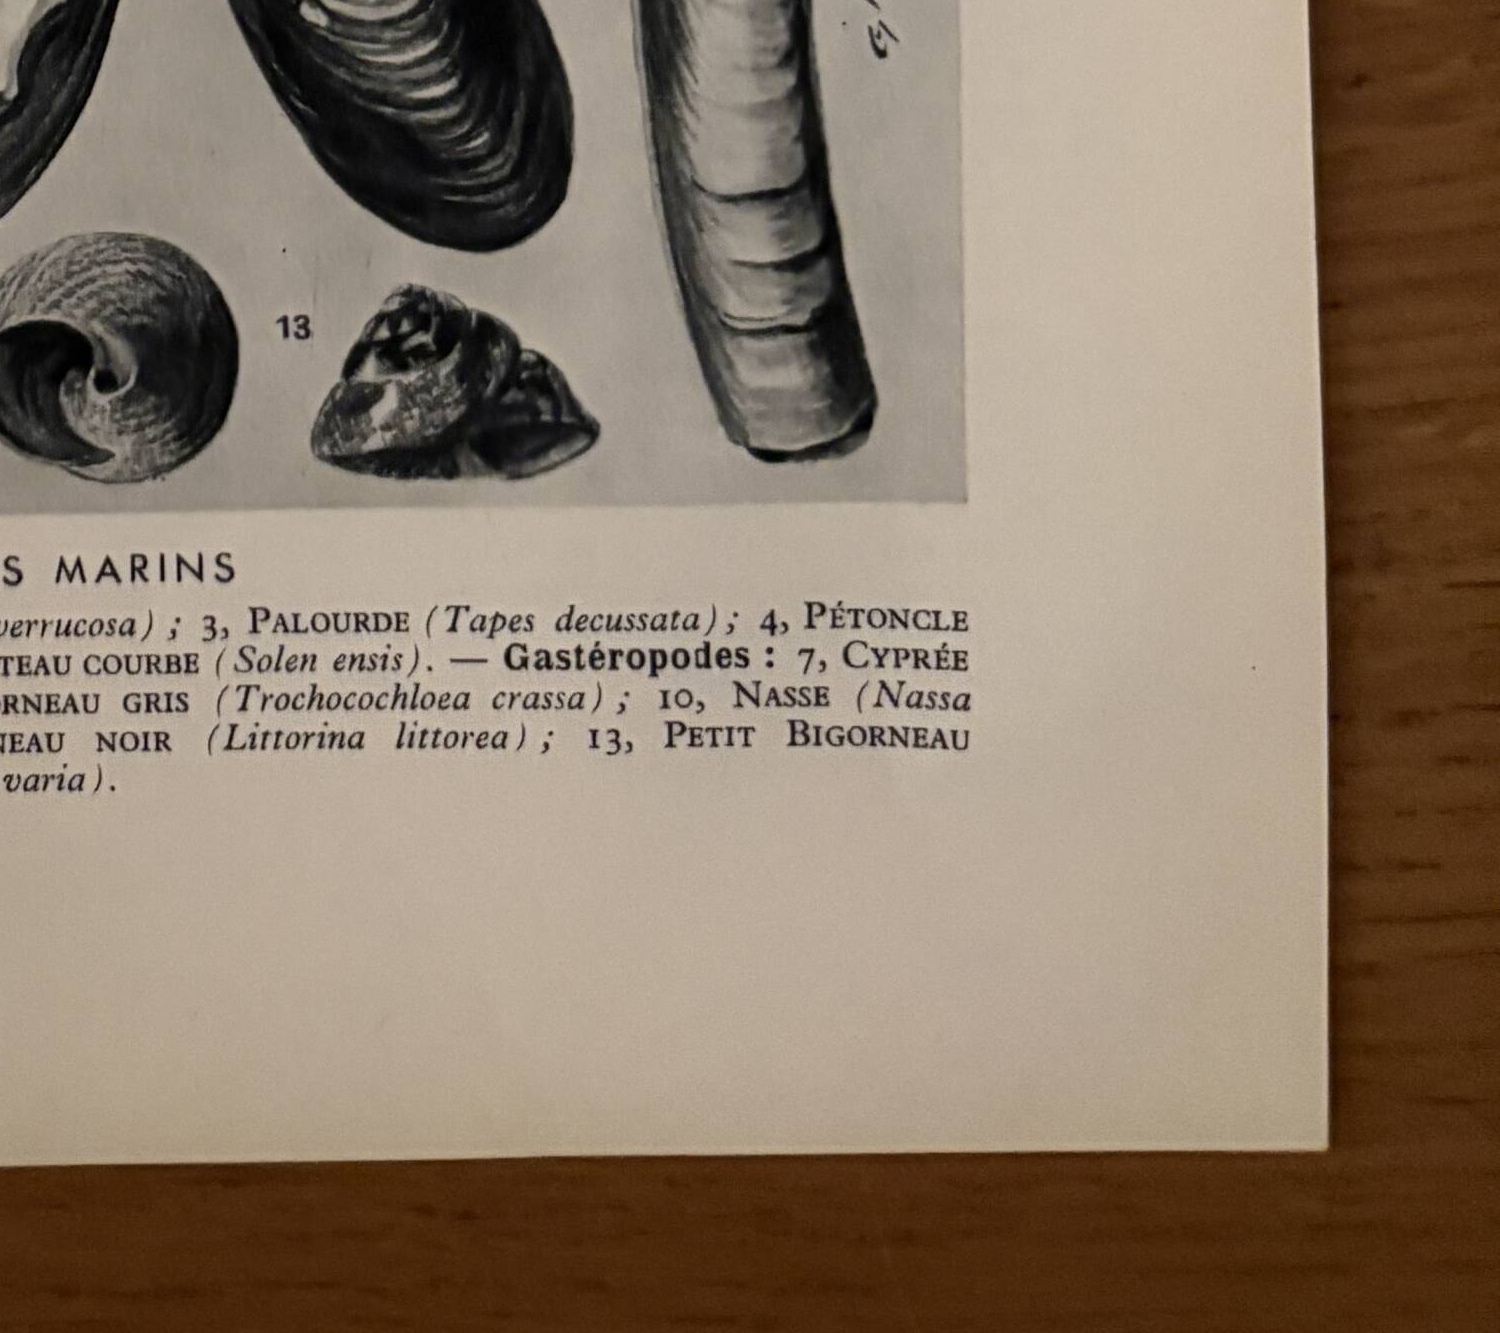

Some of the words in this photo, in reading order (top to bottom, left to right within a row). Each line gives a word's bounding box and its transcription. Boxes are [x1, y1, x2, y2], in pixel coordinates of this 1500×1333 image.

[275, 313, 314, 342] 13
[54, 551, 236, 587] MARINS
[201, 614, 230, 644] 3,
[247, 606, 410, 636] PALOURDE
[425, 604, 536, 641] (Tapes
[758, 608, 790, 638] 4,
[82, 652, 200, 677] COURBE
[215, 643, 318, 681] (Solen
[332, 642, 434, 679] ensis).
[797, 647, 828, 676] 7,
[121, 691, 190, 715] GRIS
[216, 681, 471, 719] (Trochocochloea
[658, 687, 706, 716] 10,
[731, 679, 831, 710] NASSE
[856, 679, 972, 715] (Nassa
[94, 730, 173, 754] NOIR
[207, 720, 366, 757] (Littorina
[587, 727, 634, 757] 13,
[663, 719, 757, 750] PETIT
[785, 718, 971, 752] BIGORNEAU
[2, 762, 116, 795] varia).
